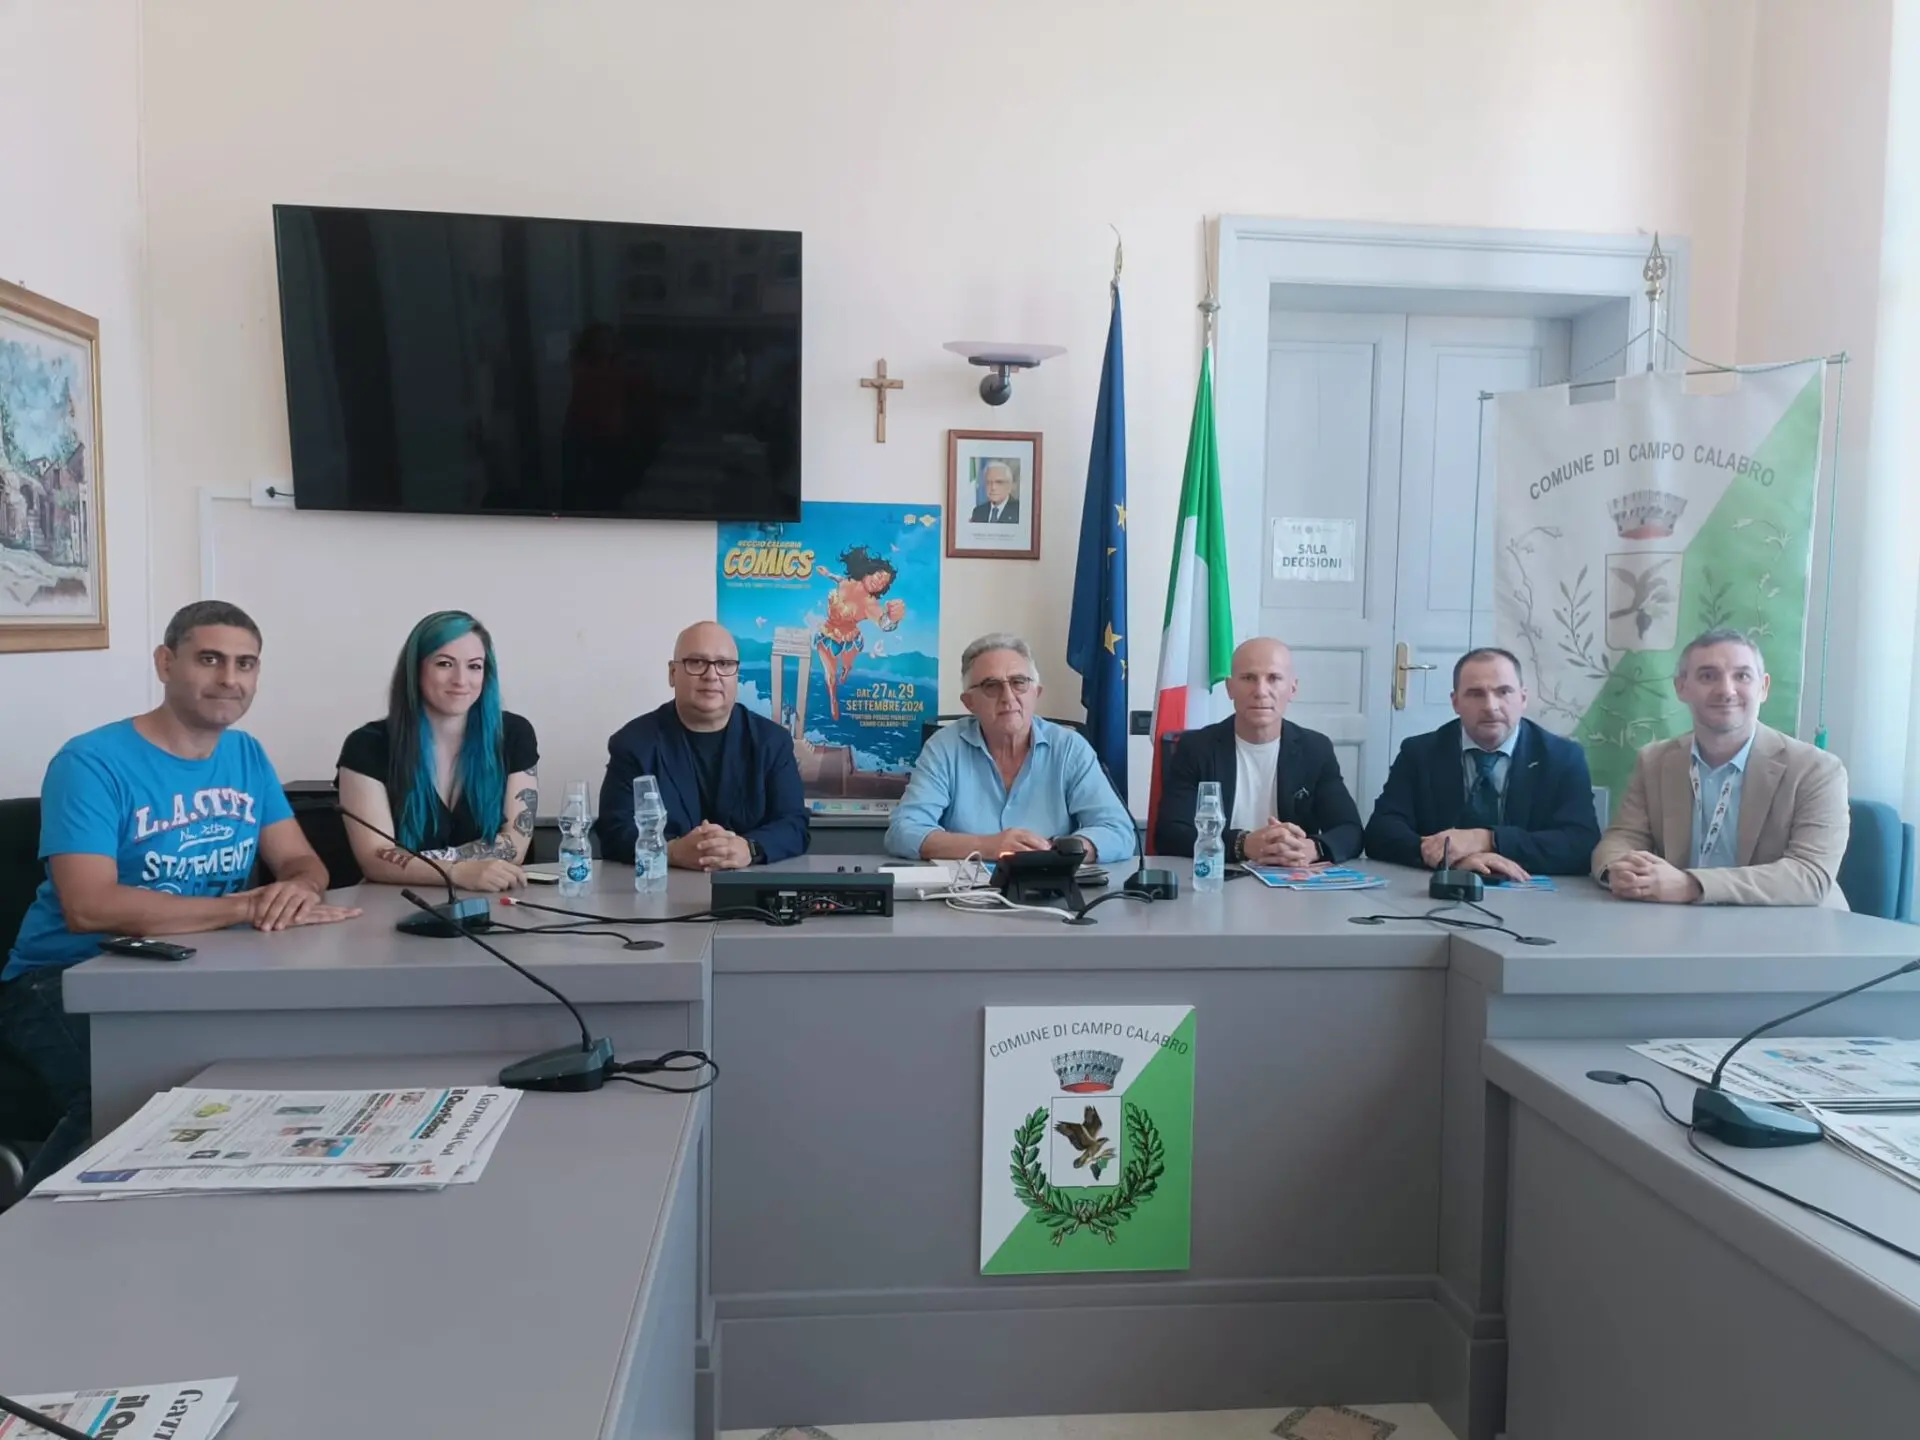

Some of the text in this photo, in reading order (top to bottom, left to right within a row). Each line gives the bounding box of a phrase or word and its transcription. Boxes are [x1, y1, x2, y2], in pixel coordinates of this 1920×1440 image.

[1530, 442, 1775, 500] COMUNE DI CAMPO CALABRO
[1298, 543, 1327, 555] SALA
[724, 548, 815, 580] COMICS
[1282, 556, 1342, 569] DECISIONI
[856, 683, 914, 699] DAL 27 AL 29
[846, 700, 924, 712] SETTEMBRE 2024
[142, 838, 254, 881] STATEMENT
[989, 1022, 1189, 1058] COMUNE DI CAMPO CALABRO
[115, 1394, 151, 1409] il
